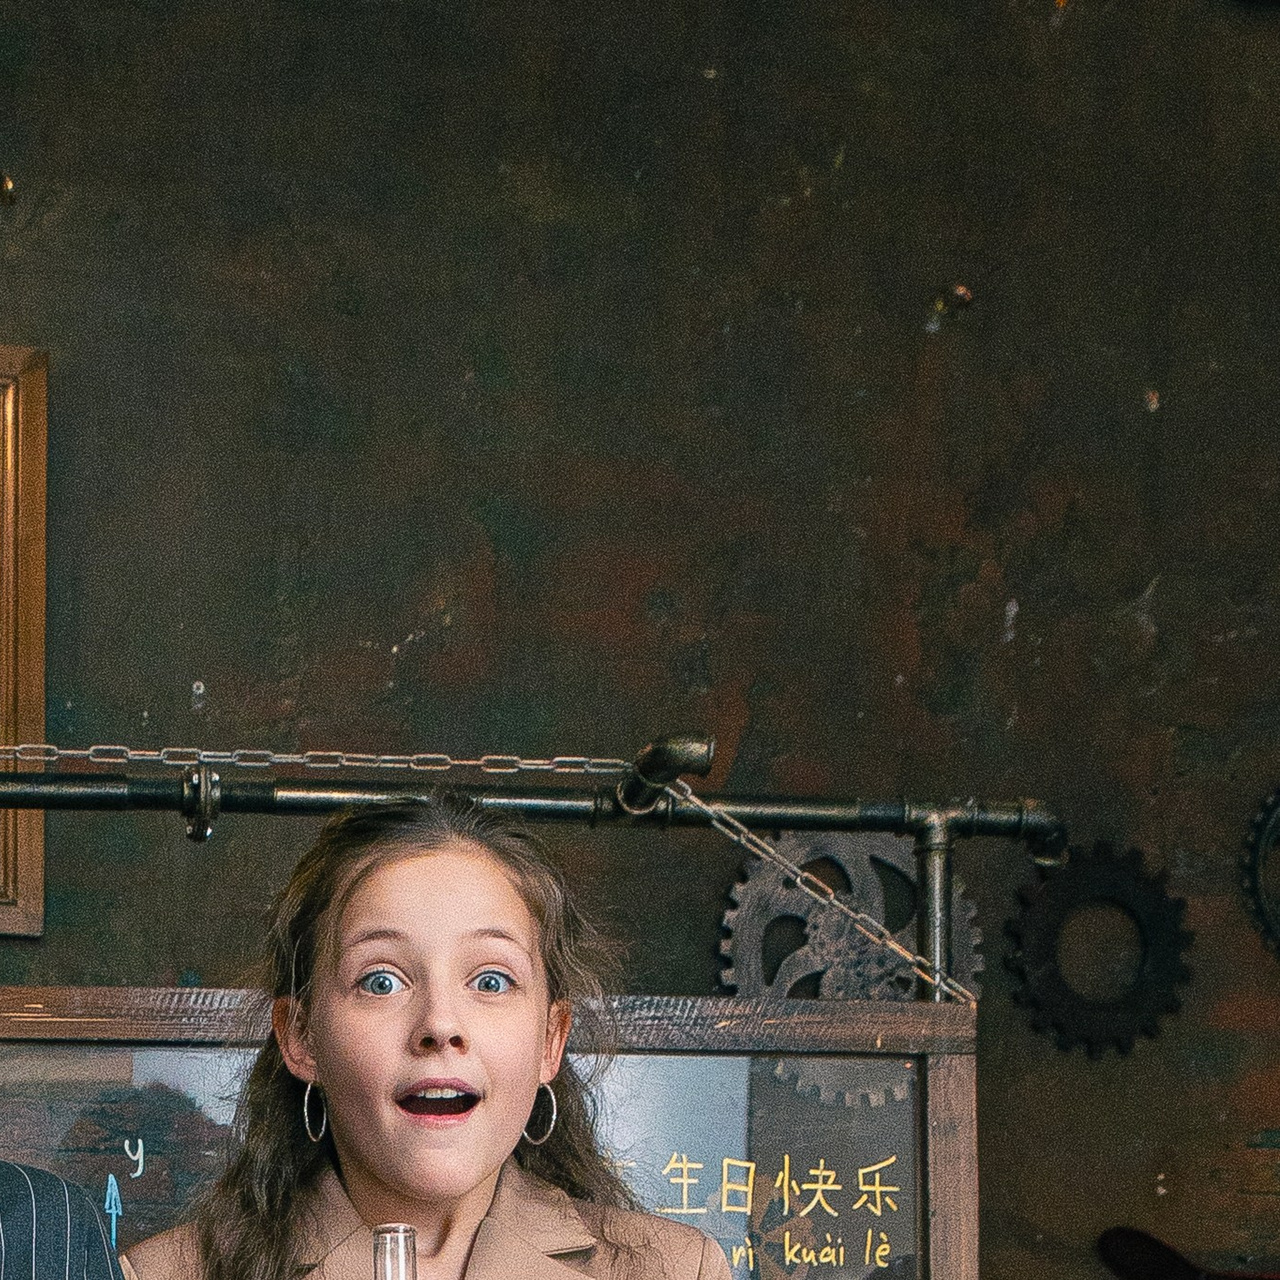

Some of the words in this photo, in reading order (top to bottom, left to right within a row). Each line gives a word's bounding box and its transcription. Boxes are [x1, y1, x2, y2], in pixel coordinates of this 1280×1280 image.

[124, 1138, 145, 1179] y
[656, 1152, 902, 1218] 生日快乐
[784, 1230, 845, 1267] kuài
[865, 1228, 891, 1269] lè
